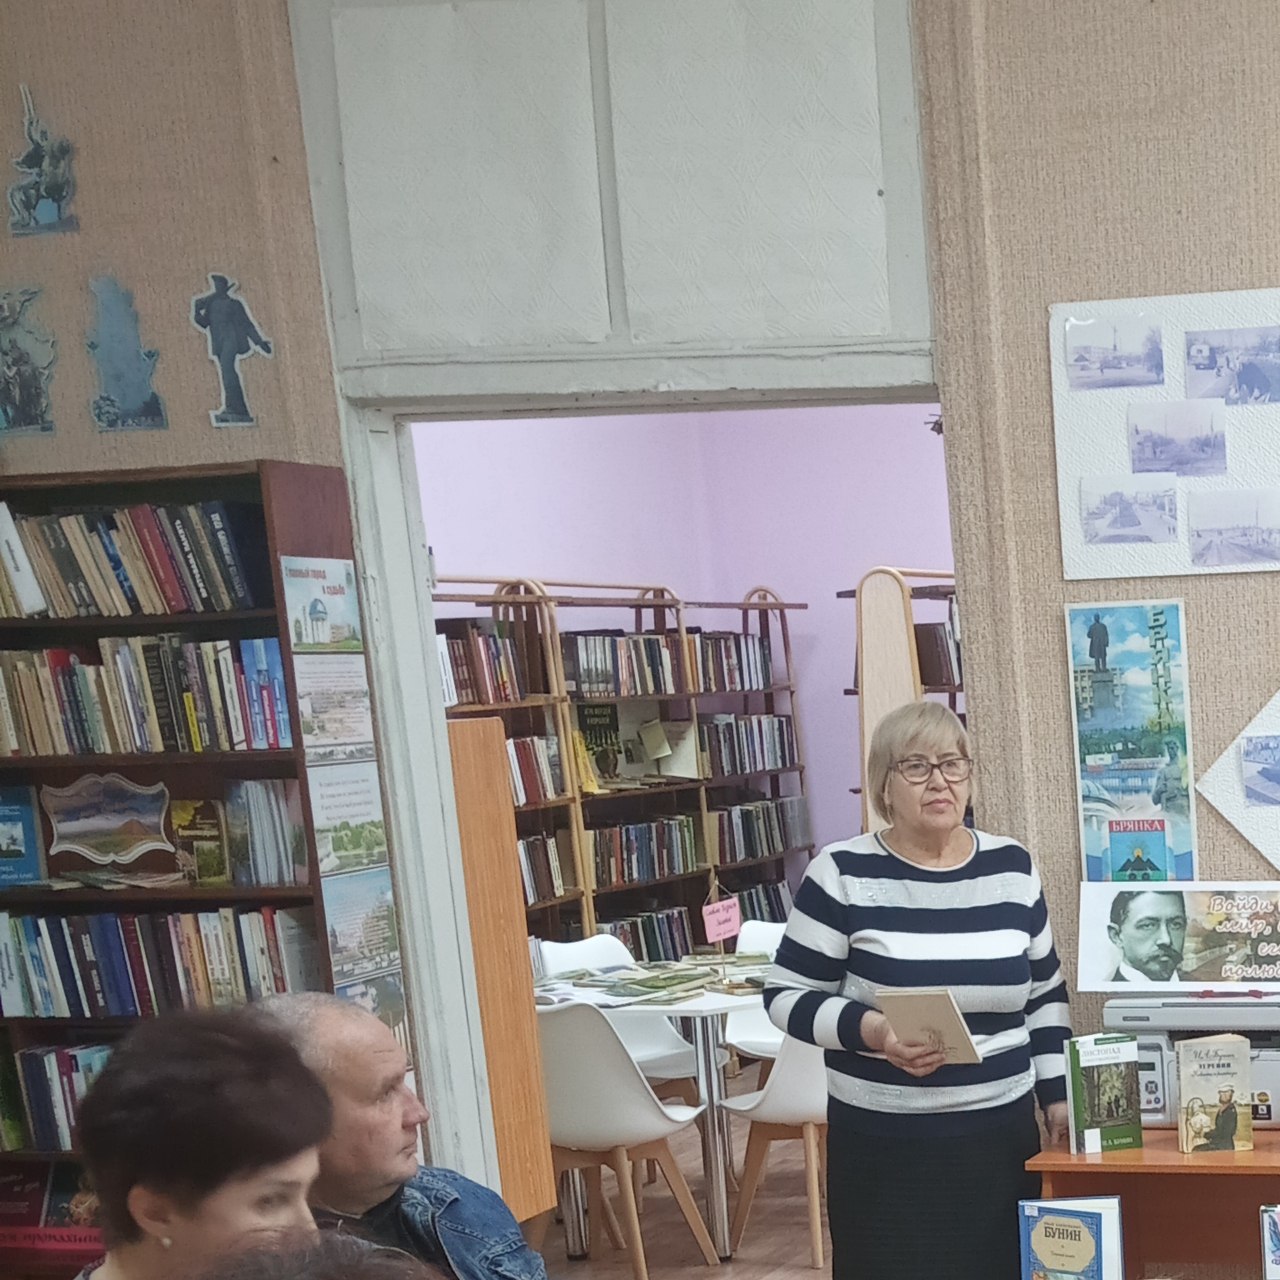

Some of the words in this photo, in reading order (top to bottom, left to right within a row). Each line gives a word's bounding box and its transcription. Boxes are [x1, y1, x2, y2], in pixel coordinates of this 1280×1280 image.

[1112, 821, 1163, 832] БРЯНКА
[1210, 897, 1274, 913] Войди
[1216, 919, 1272, 938] мир,
[1044, 1226, 1081, 1241] БУНИН
